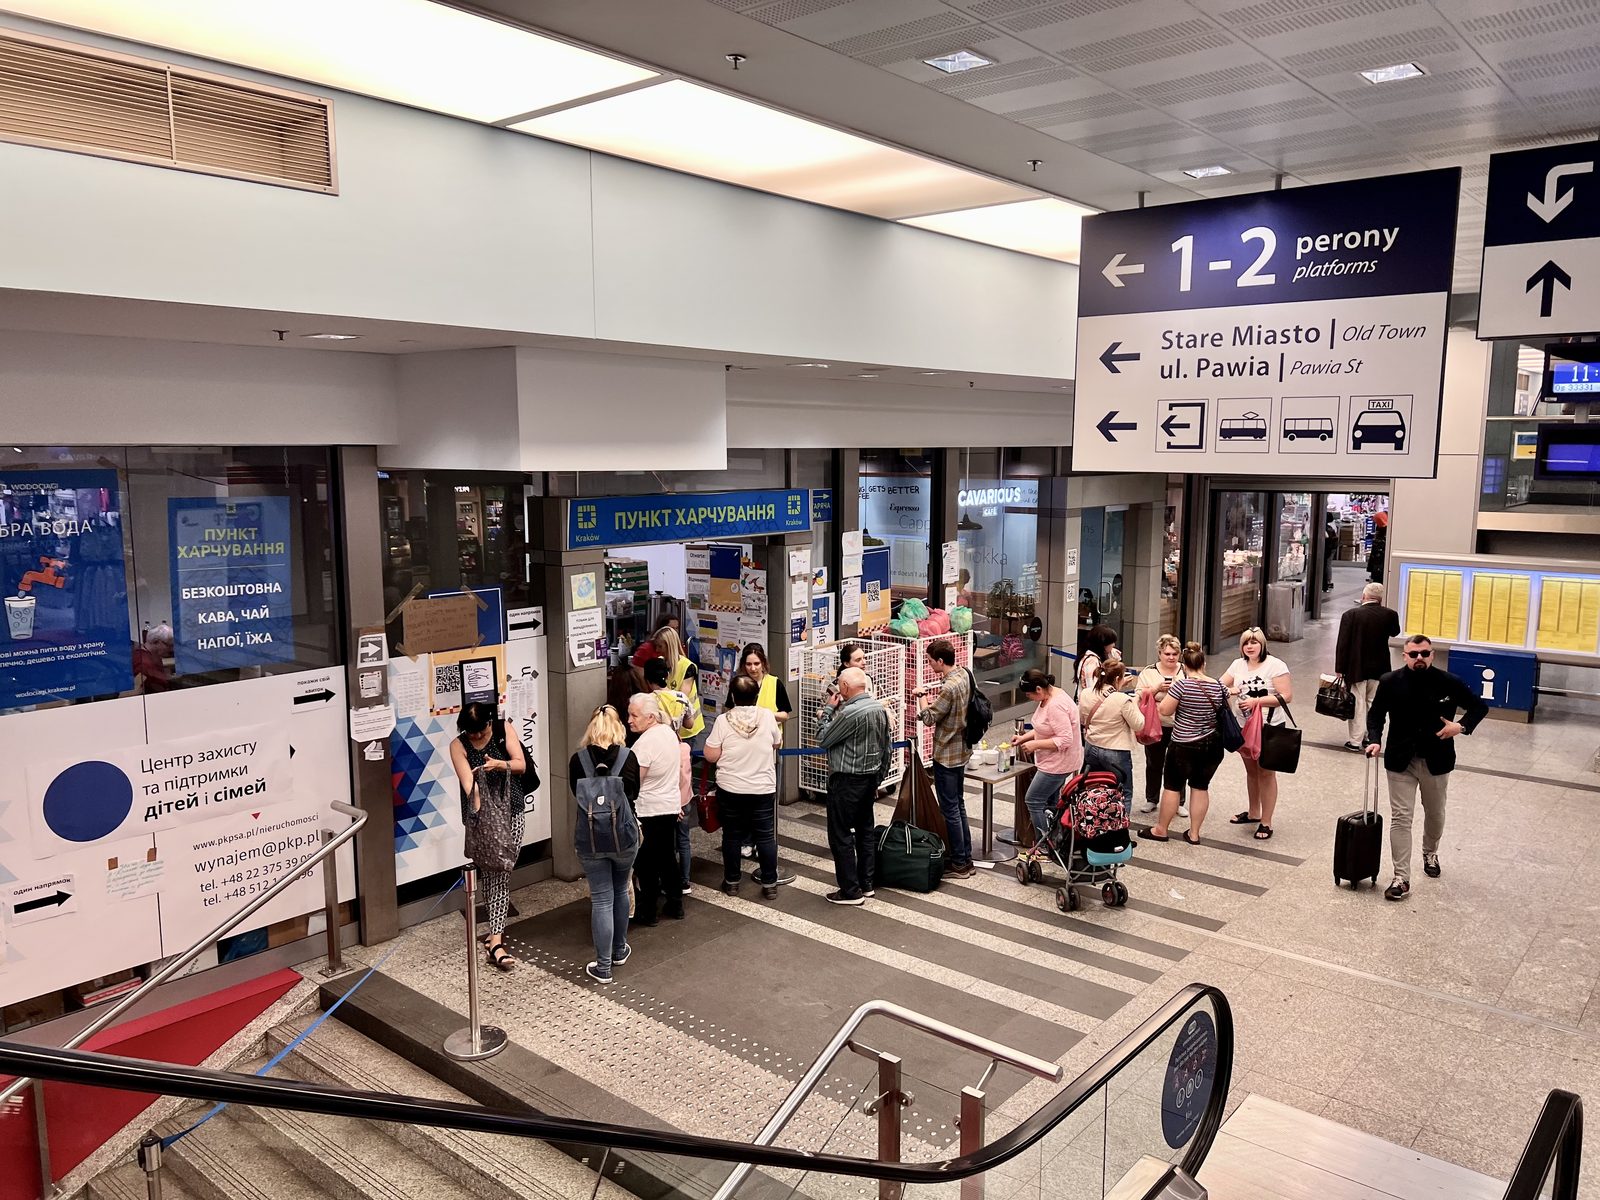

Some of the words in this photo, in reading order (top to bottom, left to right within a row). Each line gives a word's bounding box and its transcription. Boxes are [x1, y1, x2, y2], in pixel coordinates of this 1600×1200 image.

[1296, 227, 1399, 260] perony
[1292, 257, 1378, 283] platforms
[1161, 329, 1224, 350] Stare
[1232, 324, 1321, 346] Miasto
[1342, 324, 1375, 342] Old
[1378, 324, 1427, 340] Town
[1160, 358, 1188, 379] ul.
[1196, 356, 1270, 378] Pawia
[1290, 359, 1342, 376] Pawia
[1344, 358, 1363, 374] St
[888, 486, 920, 494] BETTER
[958, 487, 1021, 506] CAVARIOUS
[614, 508, 672, 530] ПУНКТ
[675, 504, 775, 526] ХАРЧУВАННЯ
[41, 519, 93, 537] ВОДА
[204, 527, 258, 542] ПУНКТ
[576, 533, 600, 542] Kraków
[177, 542, 285, 559] ХАРЧУВАННЯ
[182, 582, 282, 600] БЕЗКОШТОВНА
[198, 610, 239, 624] КАВА,
[241, 604, 270, 620] ЧАЙ
[13, 649, 39, 658] можна
[59, 644, 76, 652] воду
[83, 640, 106, 650] крану.
[198, 632, 244, 650] НАПОЇ,
[245, 631, 273, 645] ЇЖА
[26, 656, 56, 666] дешево
[66, 650, 108, 660] екологічно.
[140, 753, 194, 775] Центр
[198, 741, 258, 763] захисту
[142, 783, 160, 796] та
[164, 765, 249, 792] підтримки
[144, 792, 200, 822] дітей
[204, 792, 208, 805] і
[213, 777, 267, 803] сімей
[192, 812, 320, 851] www.pkpsa.pl/nieruchomosci
[194, 829, 320, 874] wynajem@pkp.pl
[200, 878, 218, 893] tel.
[221, 872, 244, 886] +48
[246, 868, 260, 880] 22
[262, 861, 282, 876] 375
[285, 857, 298, 870] 39
[13, 886, 33, 896] один
[34, 878, 71, 891] напрямок
[203, 893, 222, 907] tel.
[224, 886, 246, 901] +48
[249, 880, 269, 894] 512
